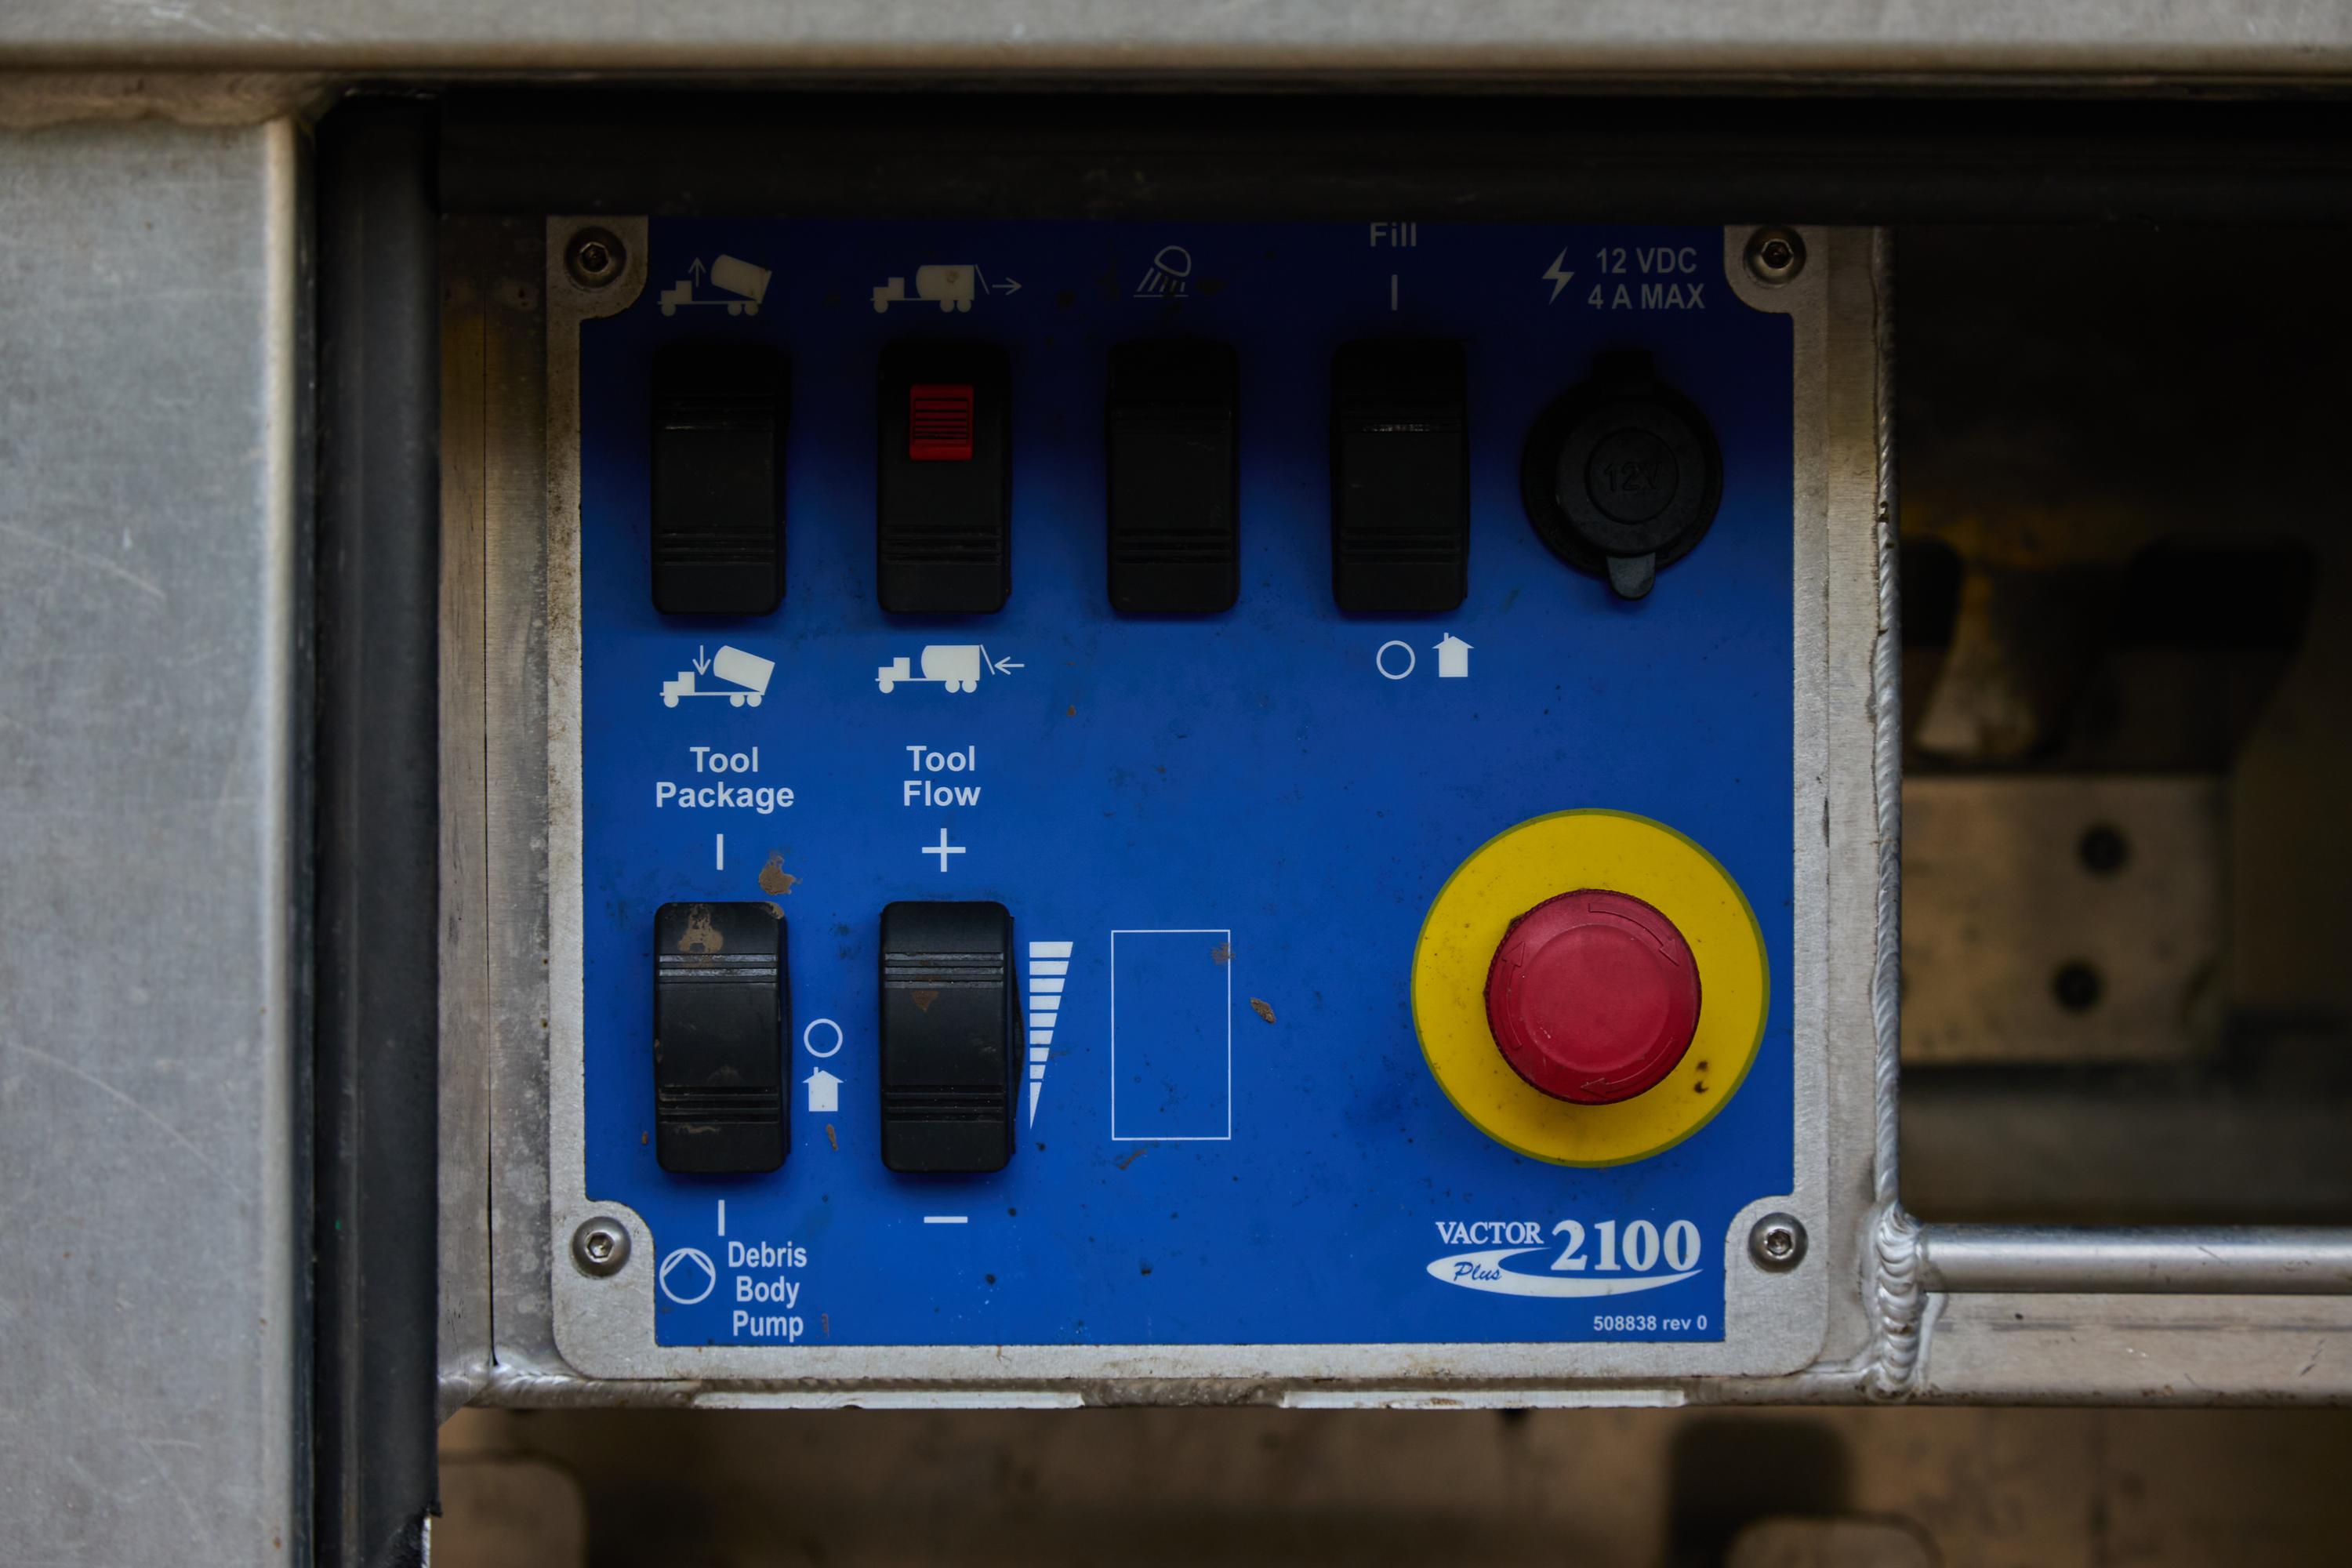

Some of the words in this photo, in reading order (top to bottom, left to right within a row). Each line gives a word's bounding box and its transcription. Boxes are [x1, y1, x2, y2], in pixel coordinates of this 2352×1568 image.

[1370, 223, 1417, 247] Fill
[1596, 248, 1627, 274] 12
[1635, 247, 1697, 274] VDC
[1588, 284, 1603, 310] 4
[1611, 284, 1632, 310] A
[1641, 284, 1706, 310] MAX
[1604, 461, 1662, 492] 12V
[690, 746, 758, 773] Tool
[906, 746, 975, 771] Tool
[655, 782, 794, 815] Package
[903, 780, 982, 807] Flow
[728, 1241, 808, 1268] Debris
[1436, 1221, 1544, 1245] VACTOR
[1551, 1220, 1701, 1272] 2100
[1454, 1261, 1502, 1281] Plus
[736, 1276, 800, 1308] Body
[732, 1310, 804, 1343] Pump
[1593, 1316, 1657, 1331] 508838
[1663, 1319, 1691, 1330] rev
[1697, 1315, 1708, 1330] 0
